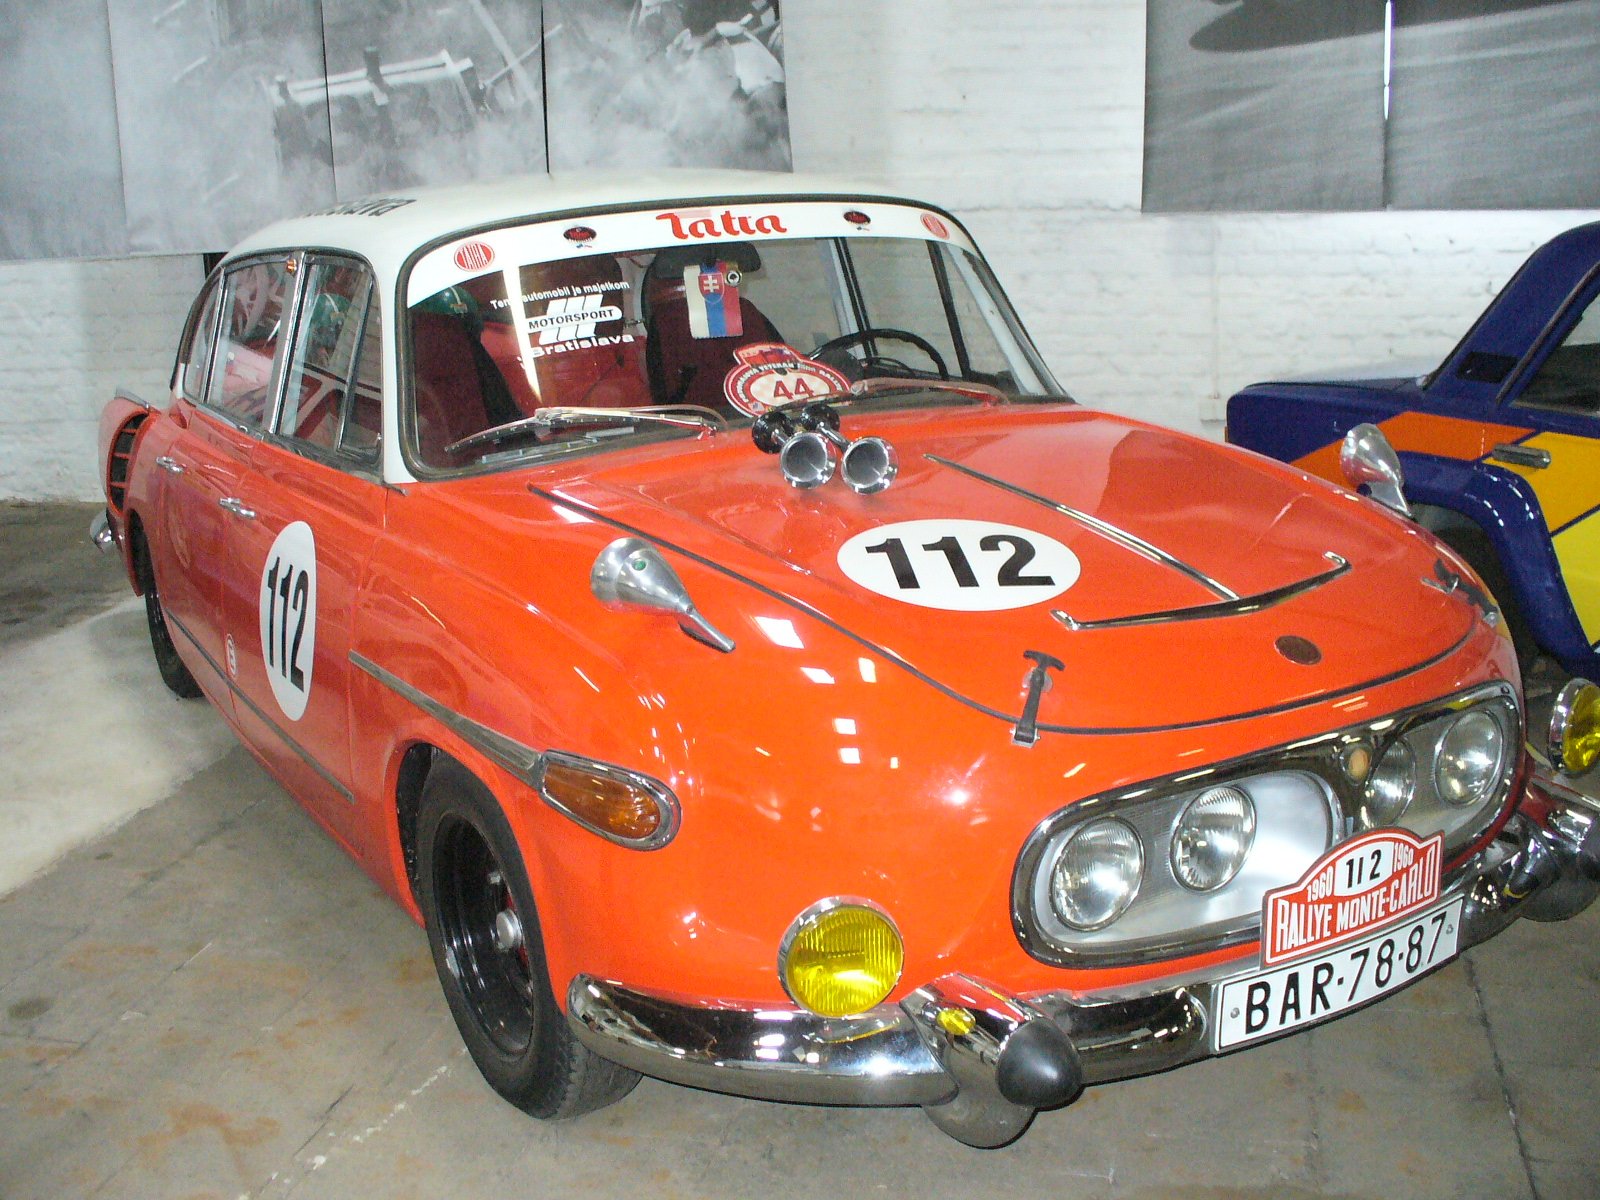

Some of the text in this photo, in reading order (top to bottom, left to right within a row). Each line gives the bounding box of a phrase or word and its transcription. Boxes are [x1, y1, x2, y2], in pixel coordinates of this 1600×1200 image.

[656, 210, 787, 240] Tatra
[522, 288, 570, 302] automobil
[572, 286, 581, 296] je
[584, 282, 630, 293] majetkom
[528, 309, 613, 328] MOTORSPORT
[533, 335, 634, 357] Bratislava
[774, 377, 815, 400] 44
[865, 534, 1056, 589] 112
[268, 556, 309, 693] 112
[1307, 842, 1415, 903] 1960 112 1960
[1275, 846, 1435, 952] RALLYE MONTE-CARLO
